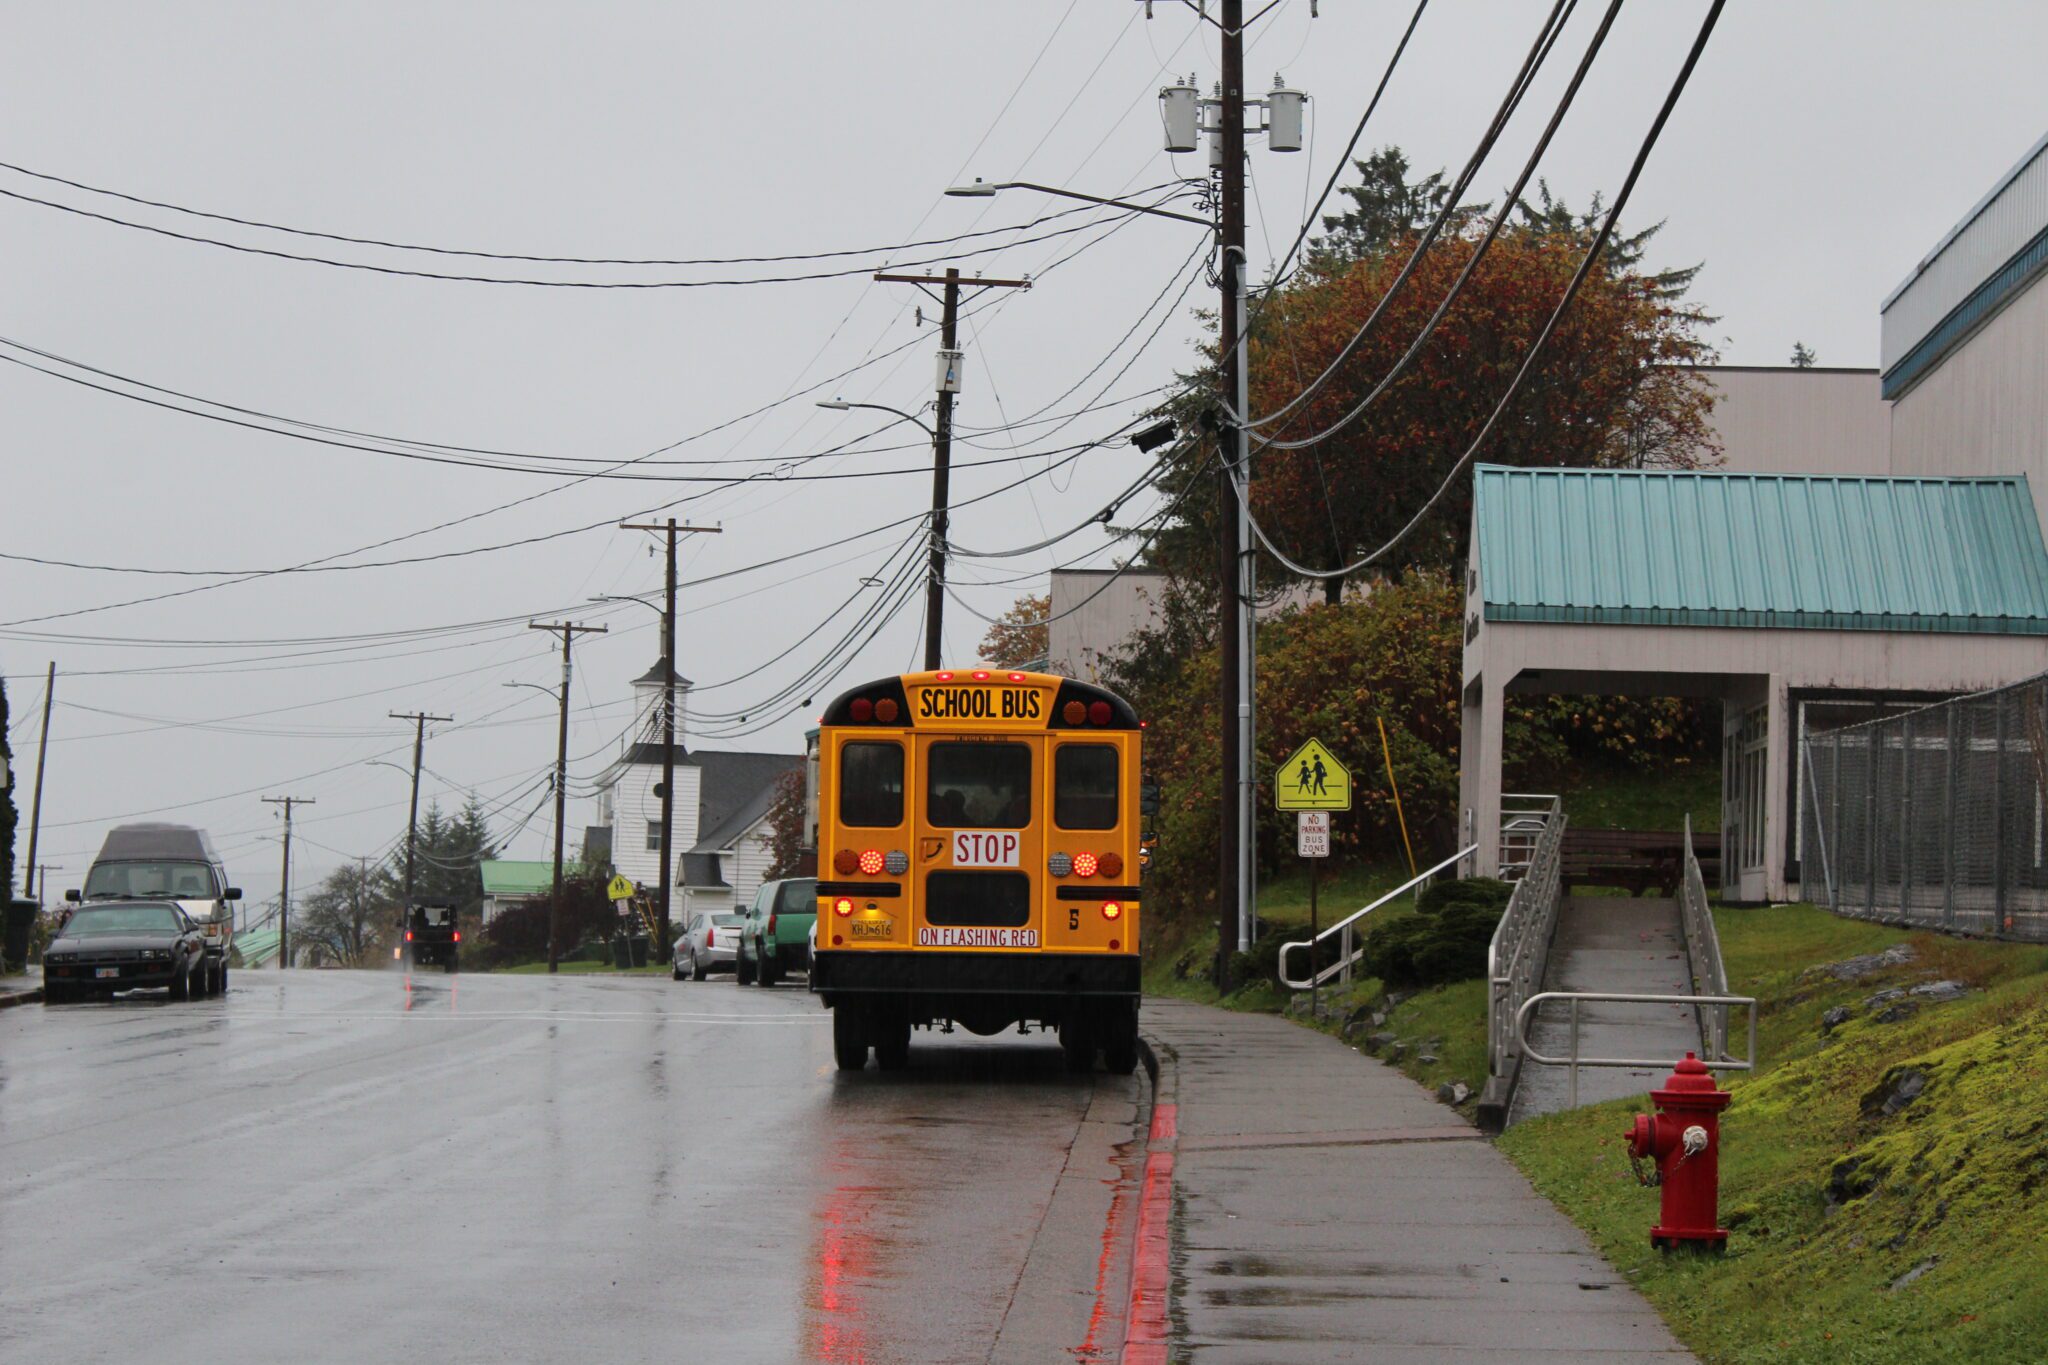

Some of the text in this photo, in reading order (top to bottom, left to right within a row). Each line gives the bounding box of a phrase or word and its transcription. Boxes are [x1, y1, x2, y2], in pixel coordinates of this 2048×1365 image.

[920, 689, 1040, 718] SCHOOL BUS
[1308, 816, 1320, 824] NO
[1301, 826, 1326, 834] PARKING
[957, 834, 1016, 863] STOP
[1069, 909, 1079, 930] 5
[921, 928, 1035, 946] ON FLASHING RED
